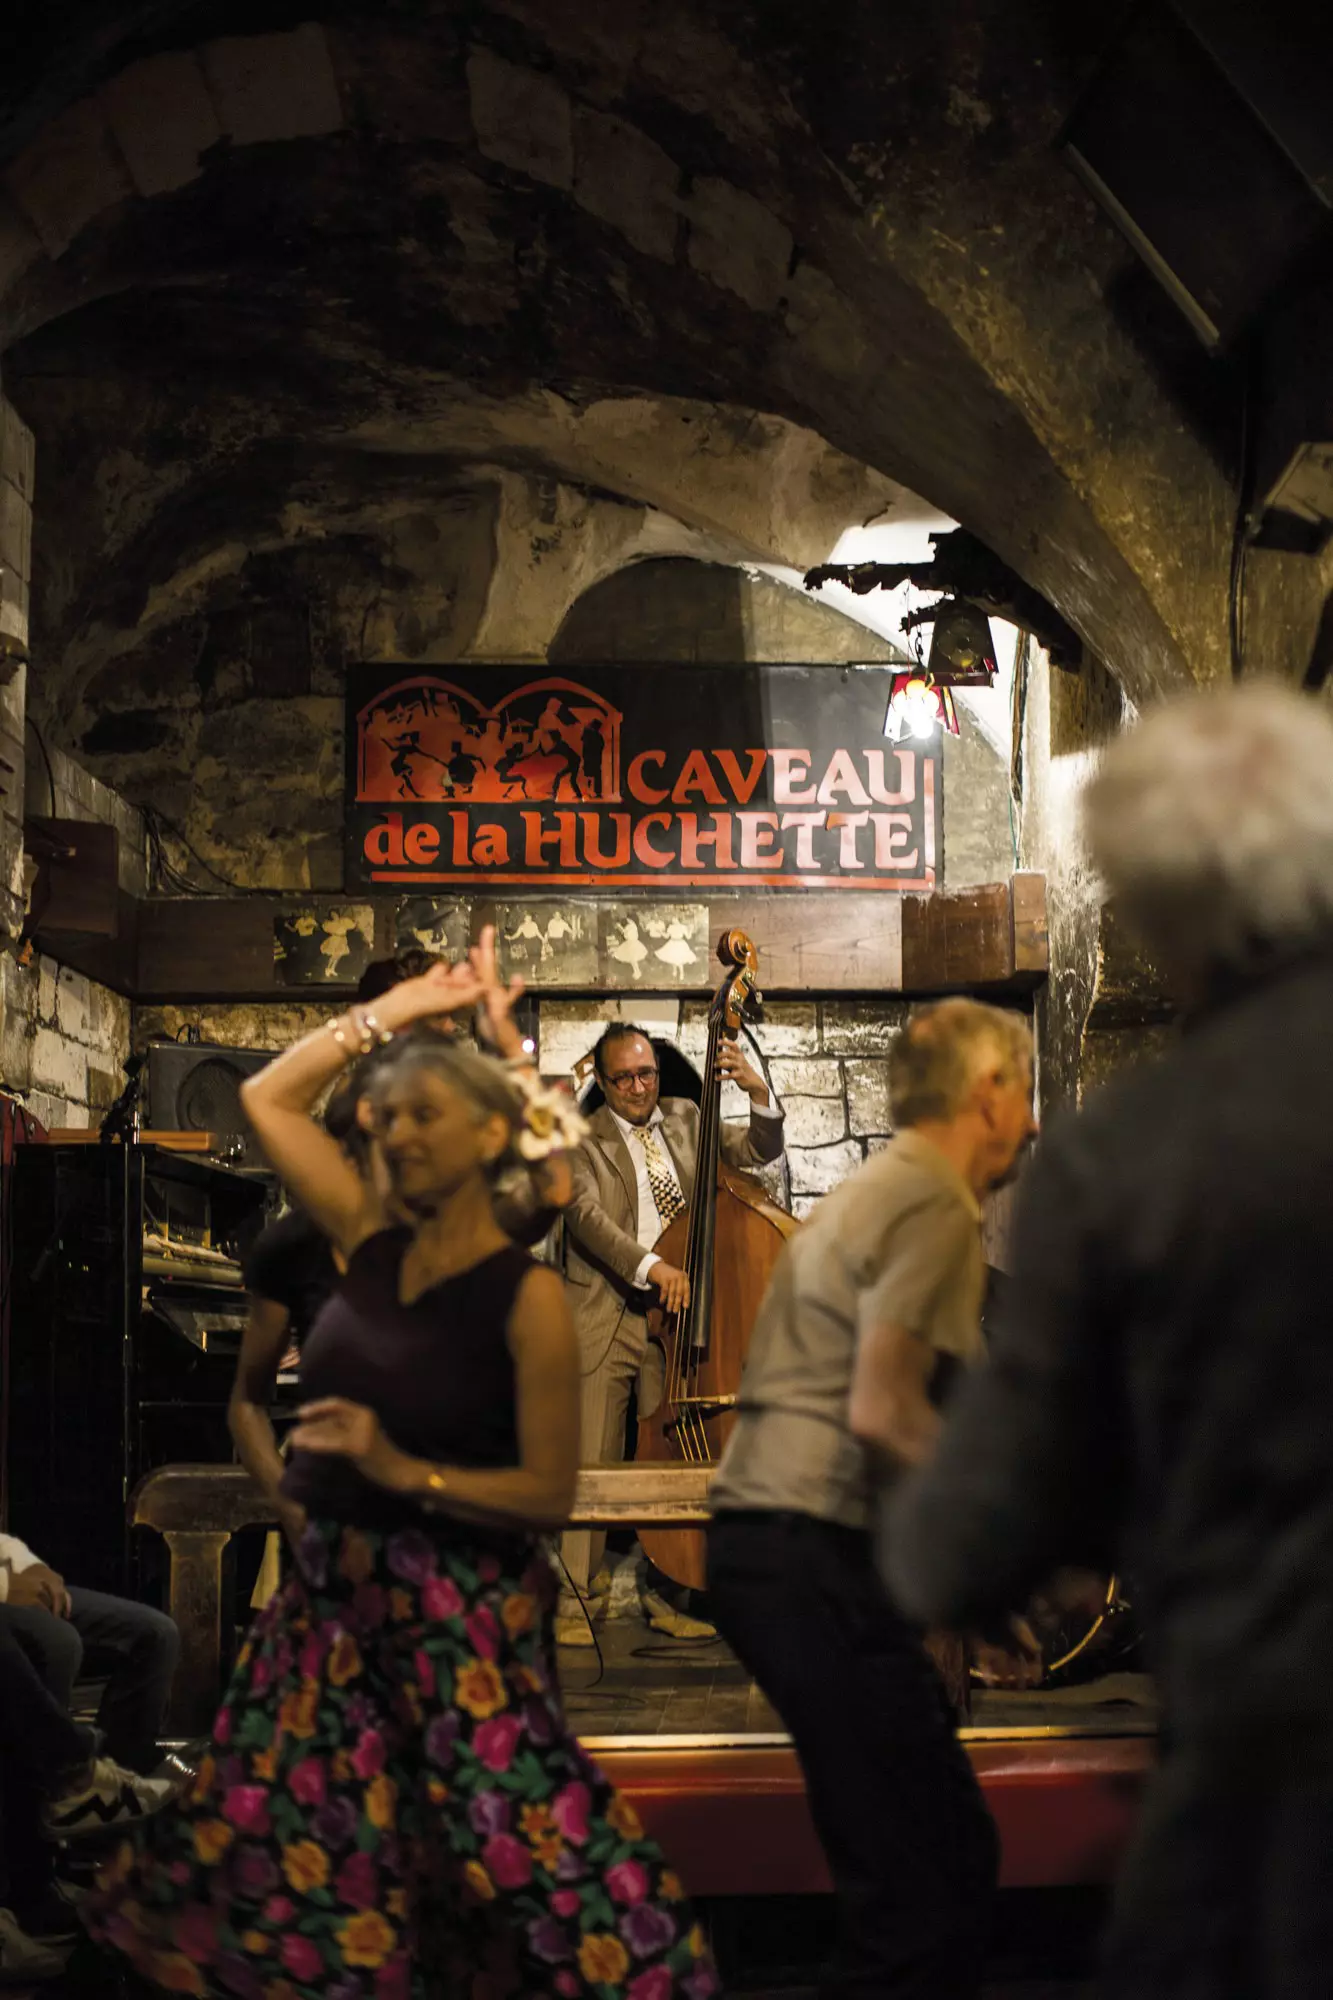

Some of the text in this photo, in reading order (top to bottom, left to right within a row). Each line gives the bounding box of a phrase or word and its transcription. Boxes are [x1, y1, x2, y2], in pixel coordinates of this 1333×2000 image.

[627, 749, 915, 805] CAVEAU
[364, 810, 919, 869] de la HUCHETTE
